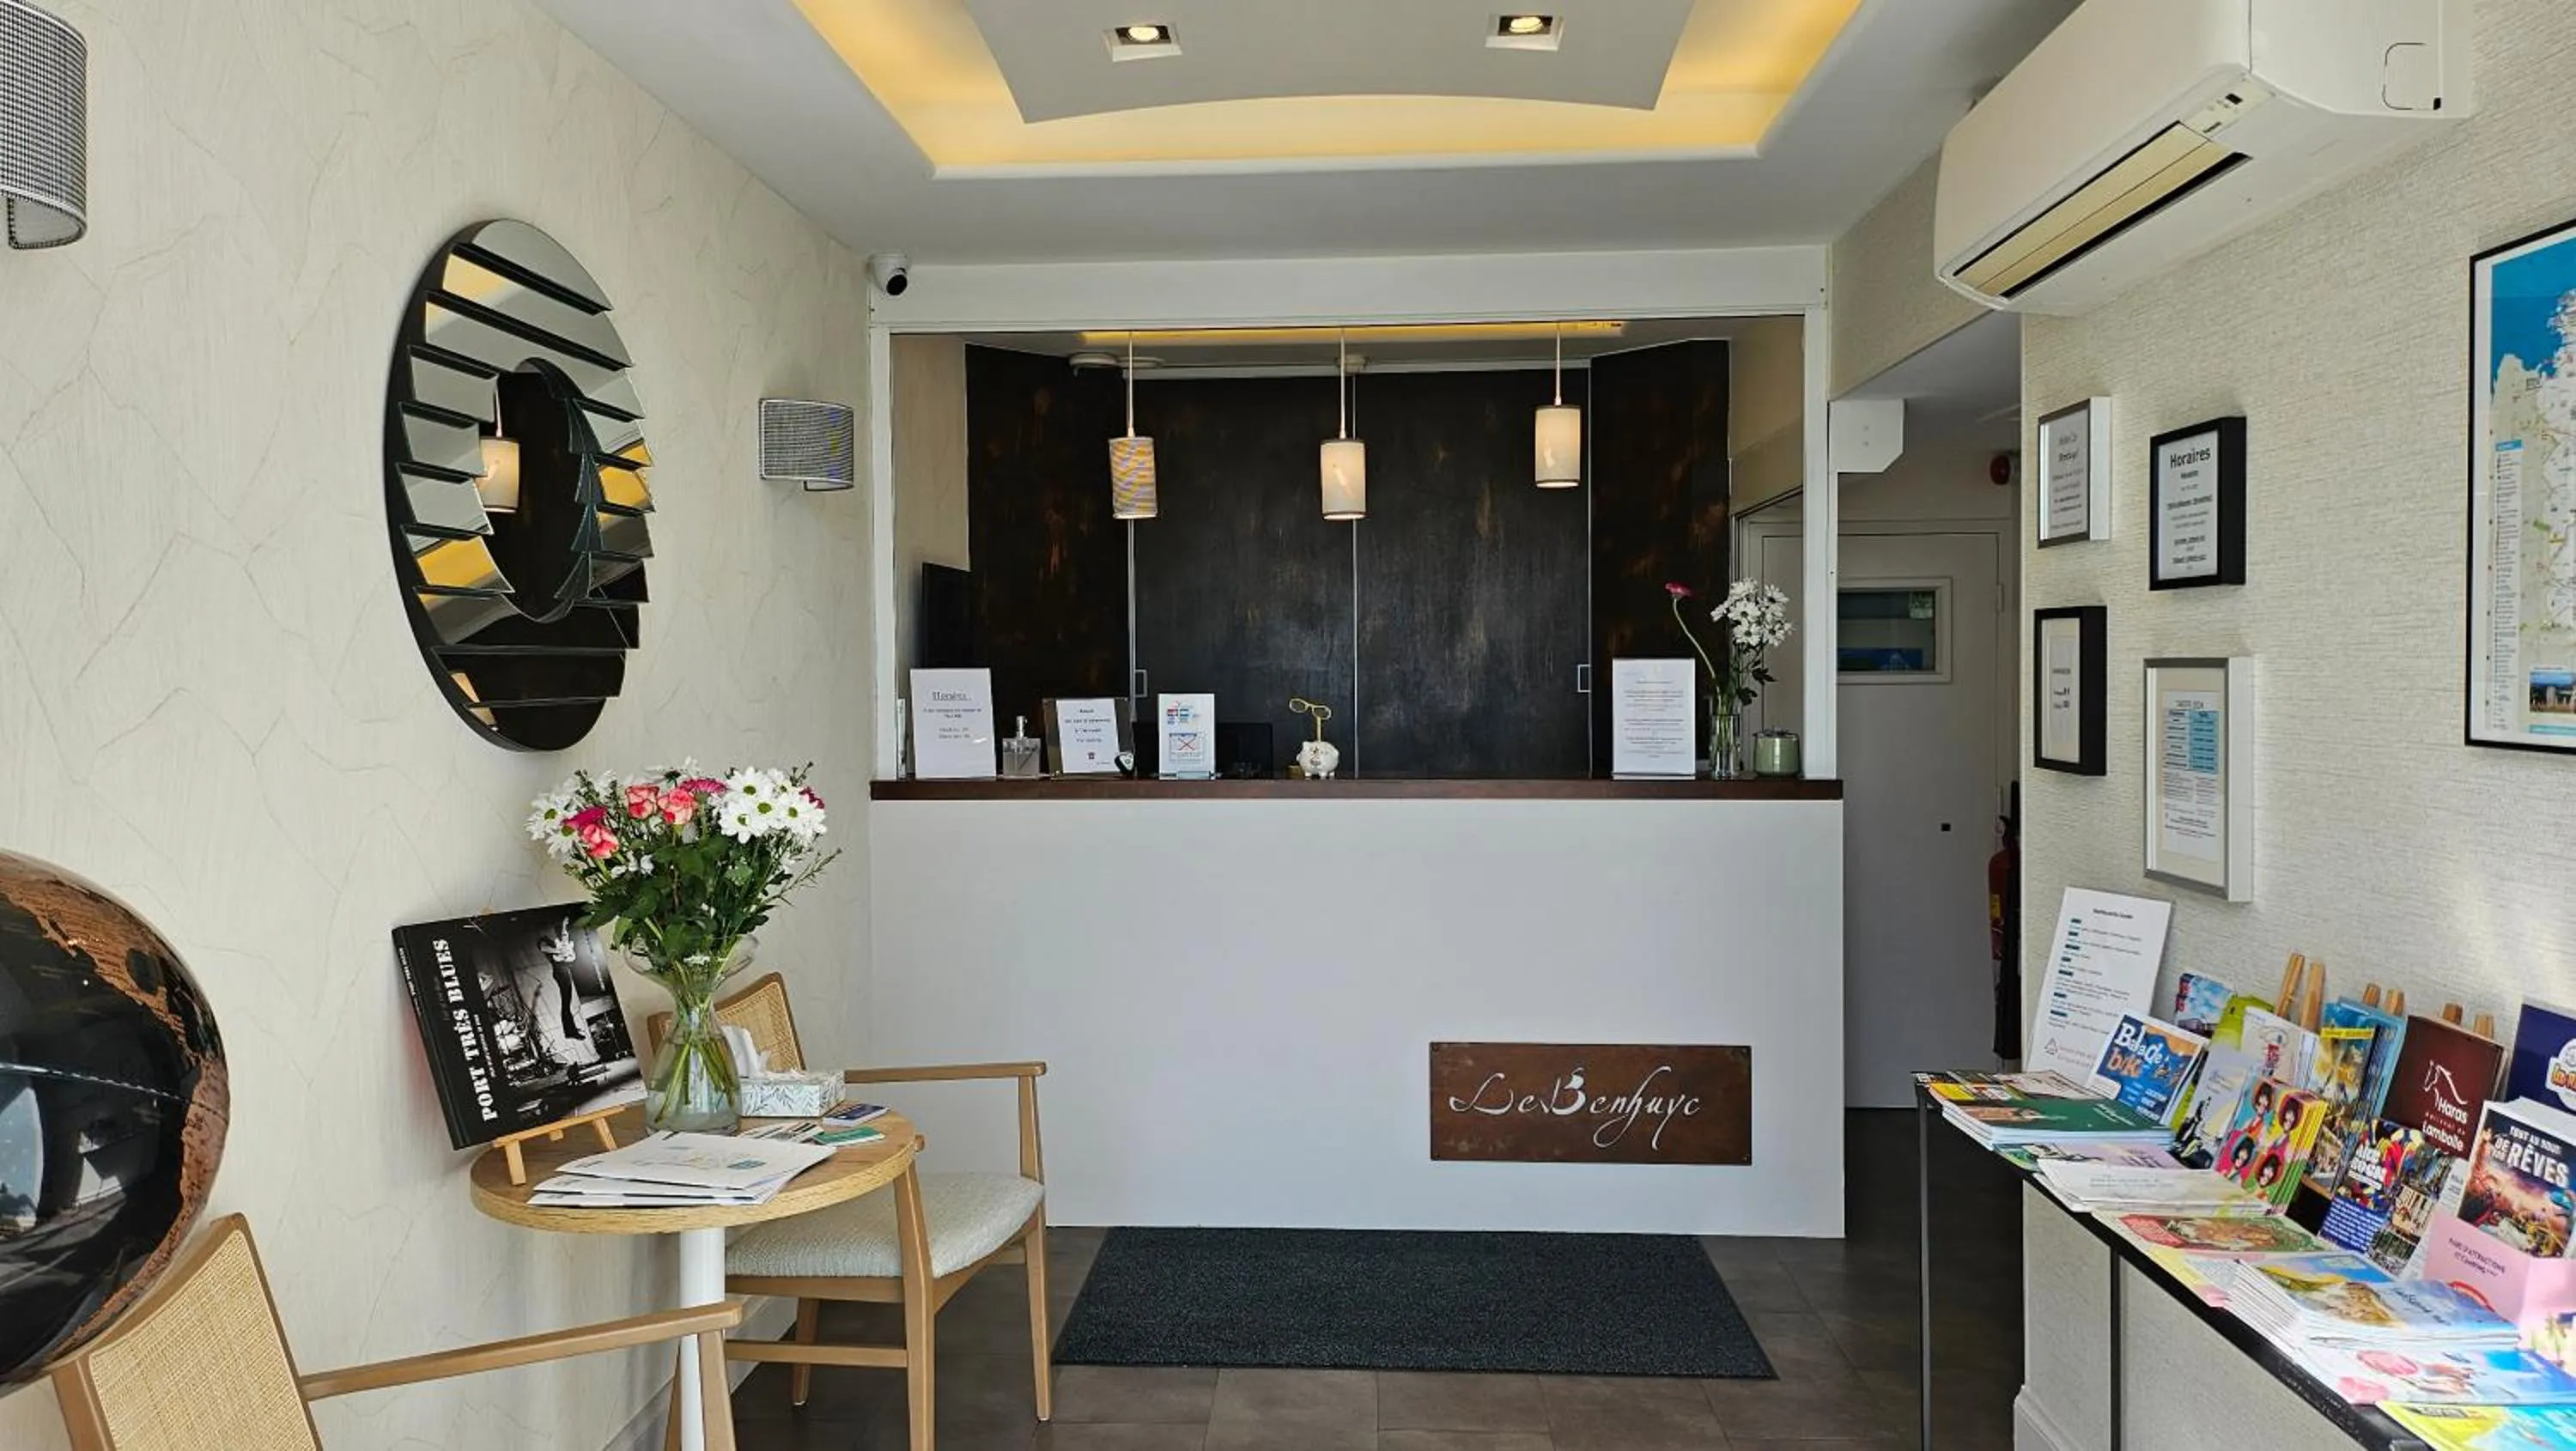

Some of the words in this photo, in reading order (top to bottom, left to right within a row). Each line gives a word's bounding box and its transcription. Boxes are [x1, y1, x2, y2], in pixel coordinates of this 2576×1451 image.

[2170, 446, 2211, 469] Horaires
[432, 938, 465, 1004] BLUES
[470, 1066, 498, 1122] PORT
[1449, 1072, 1536, 1115] Le
[2438, 1096, 2469, 1125] Haras
[2507, 1142, 2570, 1188] RÊVES
